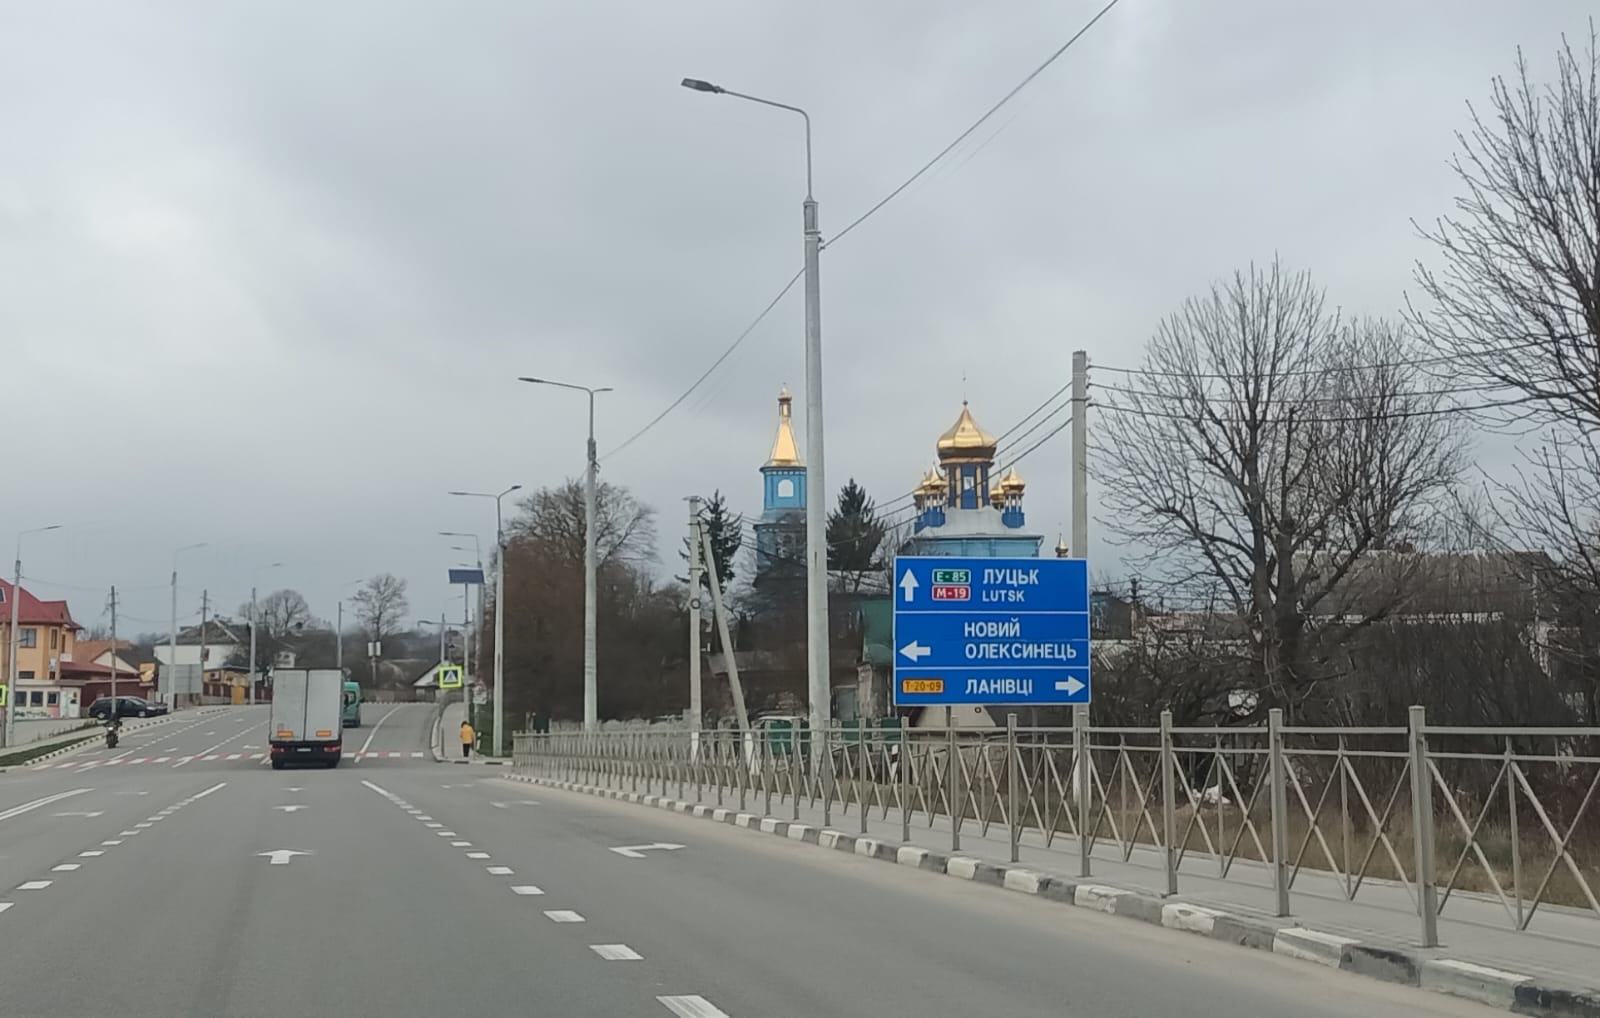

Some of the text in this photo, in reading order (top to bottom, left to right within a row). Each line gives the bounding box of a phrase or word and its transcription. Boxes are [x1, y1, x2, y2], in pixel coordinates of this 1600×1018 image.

[983, 569, 1039, 587] ЛУЦЬК
[982, 590, 1025, 602] LUTSK
[964, 617, 1020, 637] НОВИЙ
[965, 643, 1077, 661] ОЛЕКСИНЕЦЬ
[965, 679, 1032, 696] ЛАНІВЦІ
